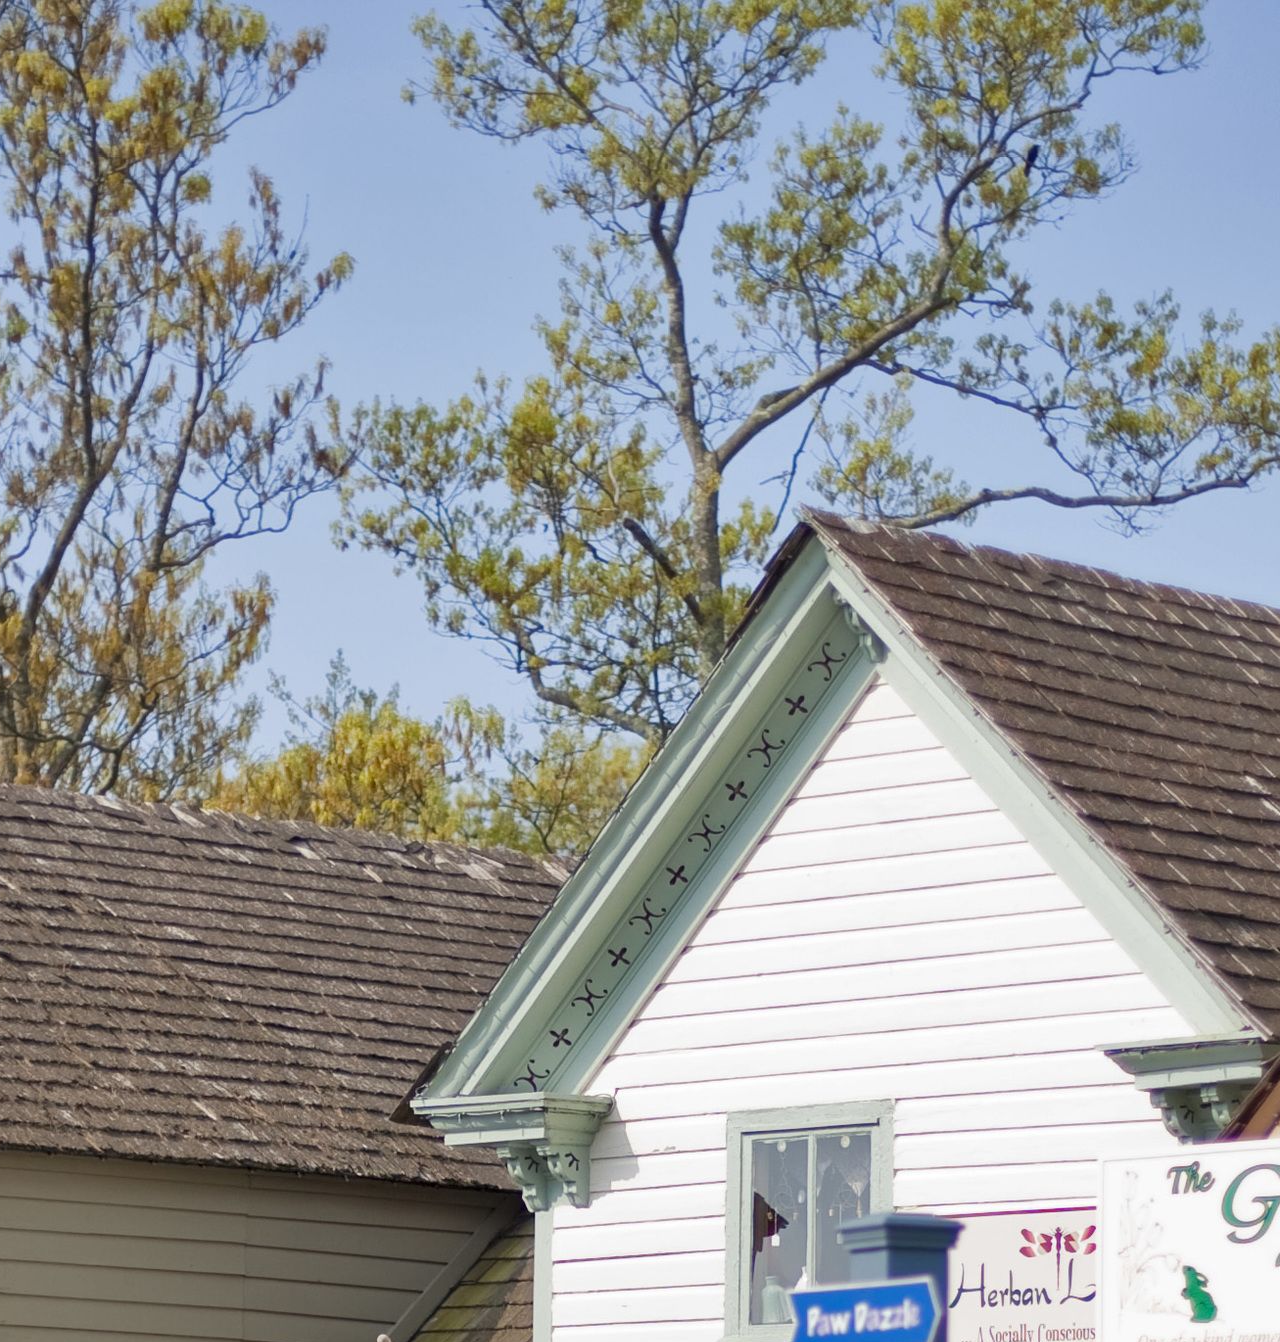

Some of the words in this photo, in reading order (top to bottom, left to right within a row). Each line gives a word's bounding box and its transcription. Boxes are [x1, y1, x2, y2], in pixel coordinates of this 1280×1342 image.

[1167, 1161, 1216, 1195] The
[948, 1262, 1052, 1308] Herban
[807, 1305, 851, 1337] Paw
[854, 1298, 920, 1333] Dazzle
